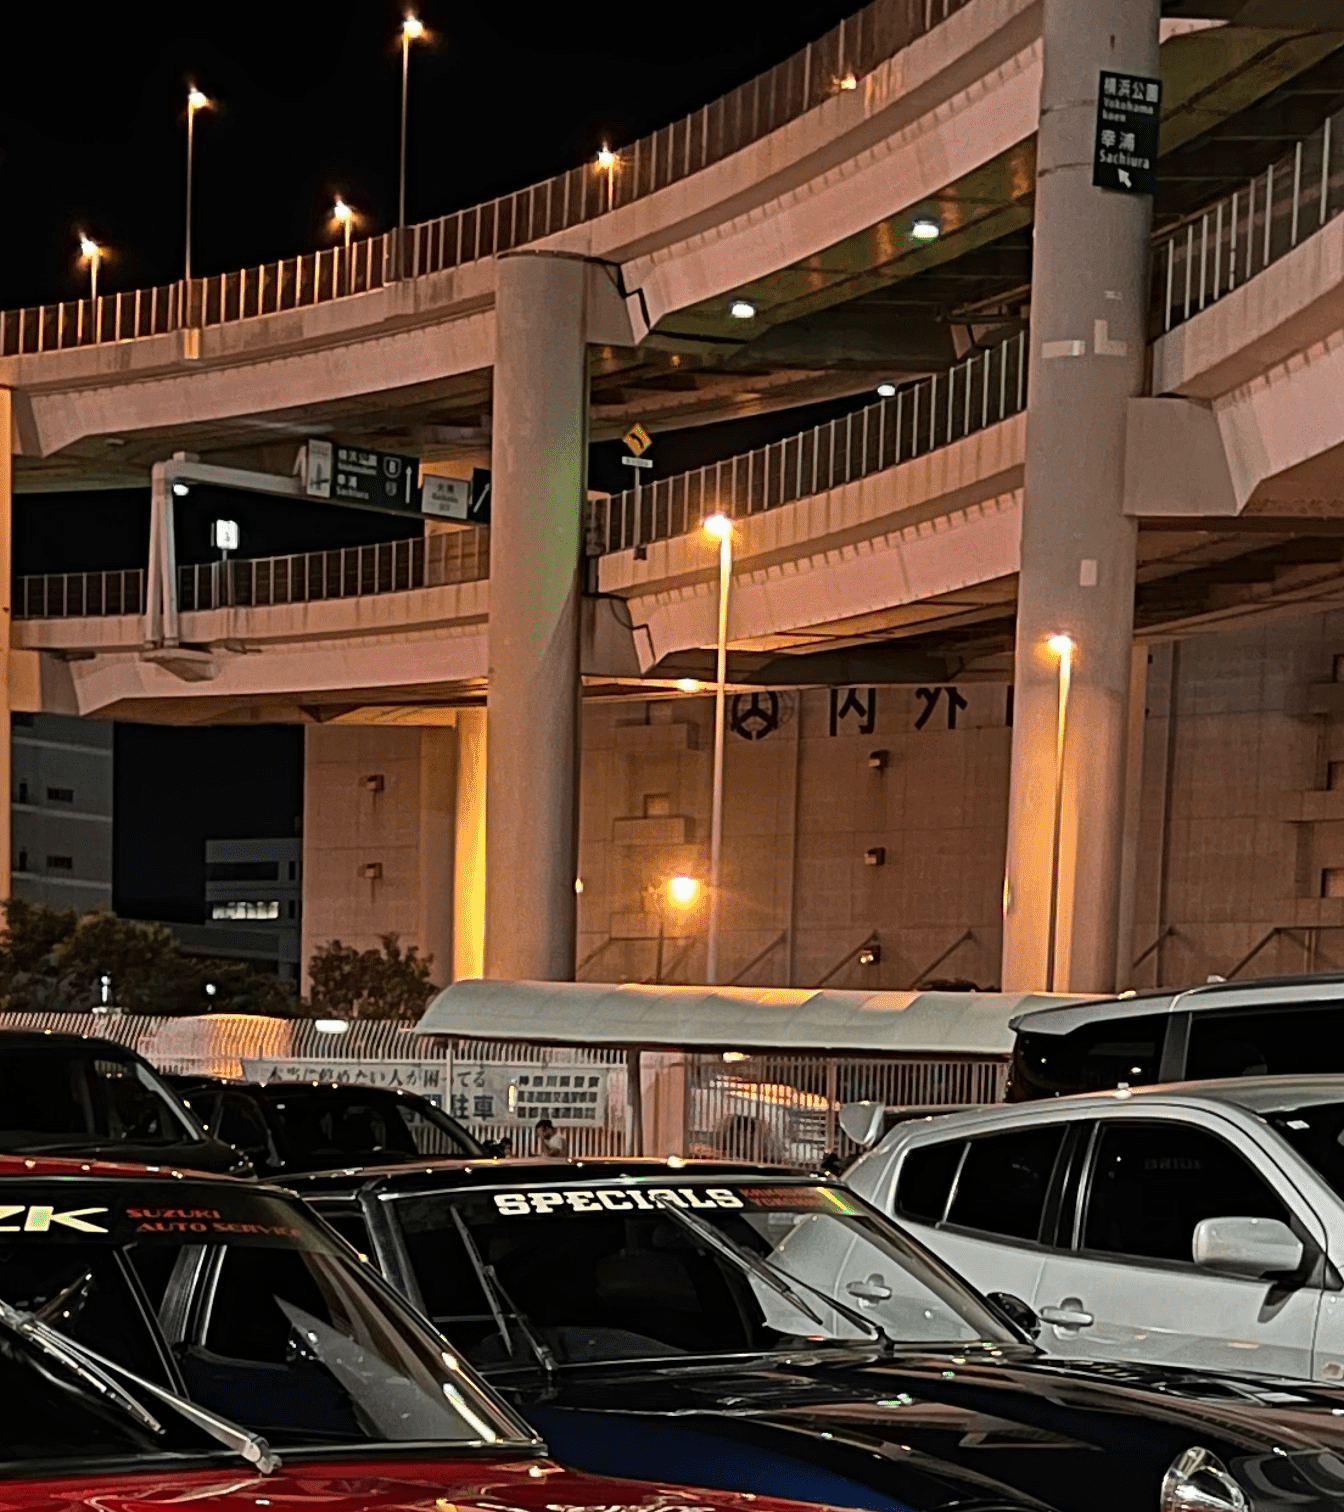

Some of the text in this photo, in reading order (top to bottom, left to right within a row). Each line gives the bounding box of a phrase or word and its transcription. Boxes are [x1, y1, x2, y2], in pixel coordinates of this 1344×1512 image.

[1104, 77, 1159, 103] 横浜公園
[1102, 109, 1127, 122] koen
[1103, 97, 1154, 115] Yokohama
[1101, 129, 1136, 152] 幸浦
[1099, 149, 1150, 170] Sachiura
[829, 686, 1013, 737] 内外
[494, 1188, 744, 1215] SPECIALS
[126, 1208, 221, 1219] SUZUKI
[136, 1222, 207, 1232] AUTO
